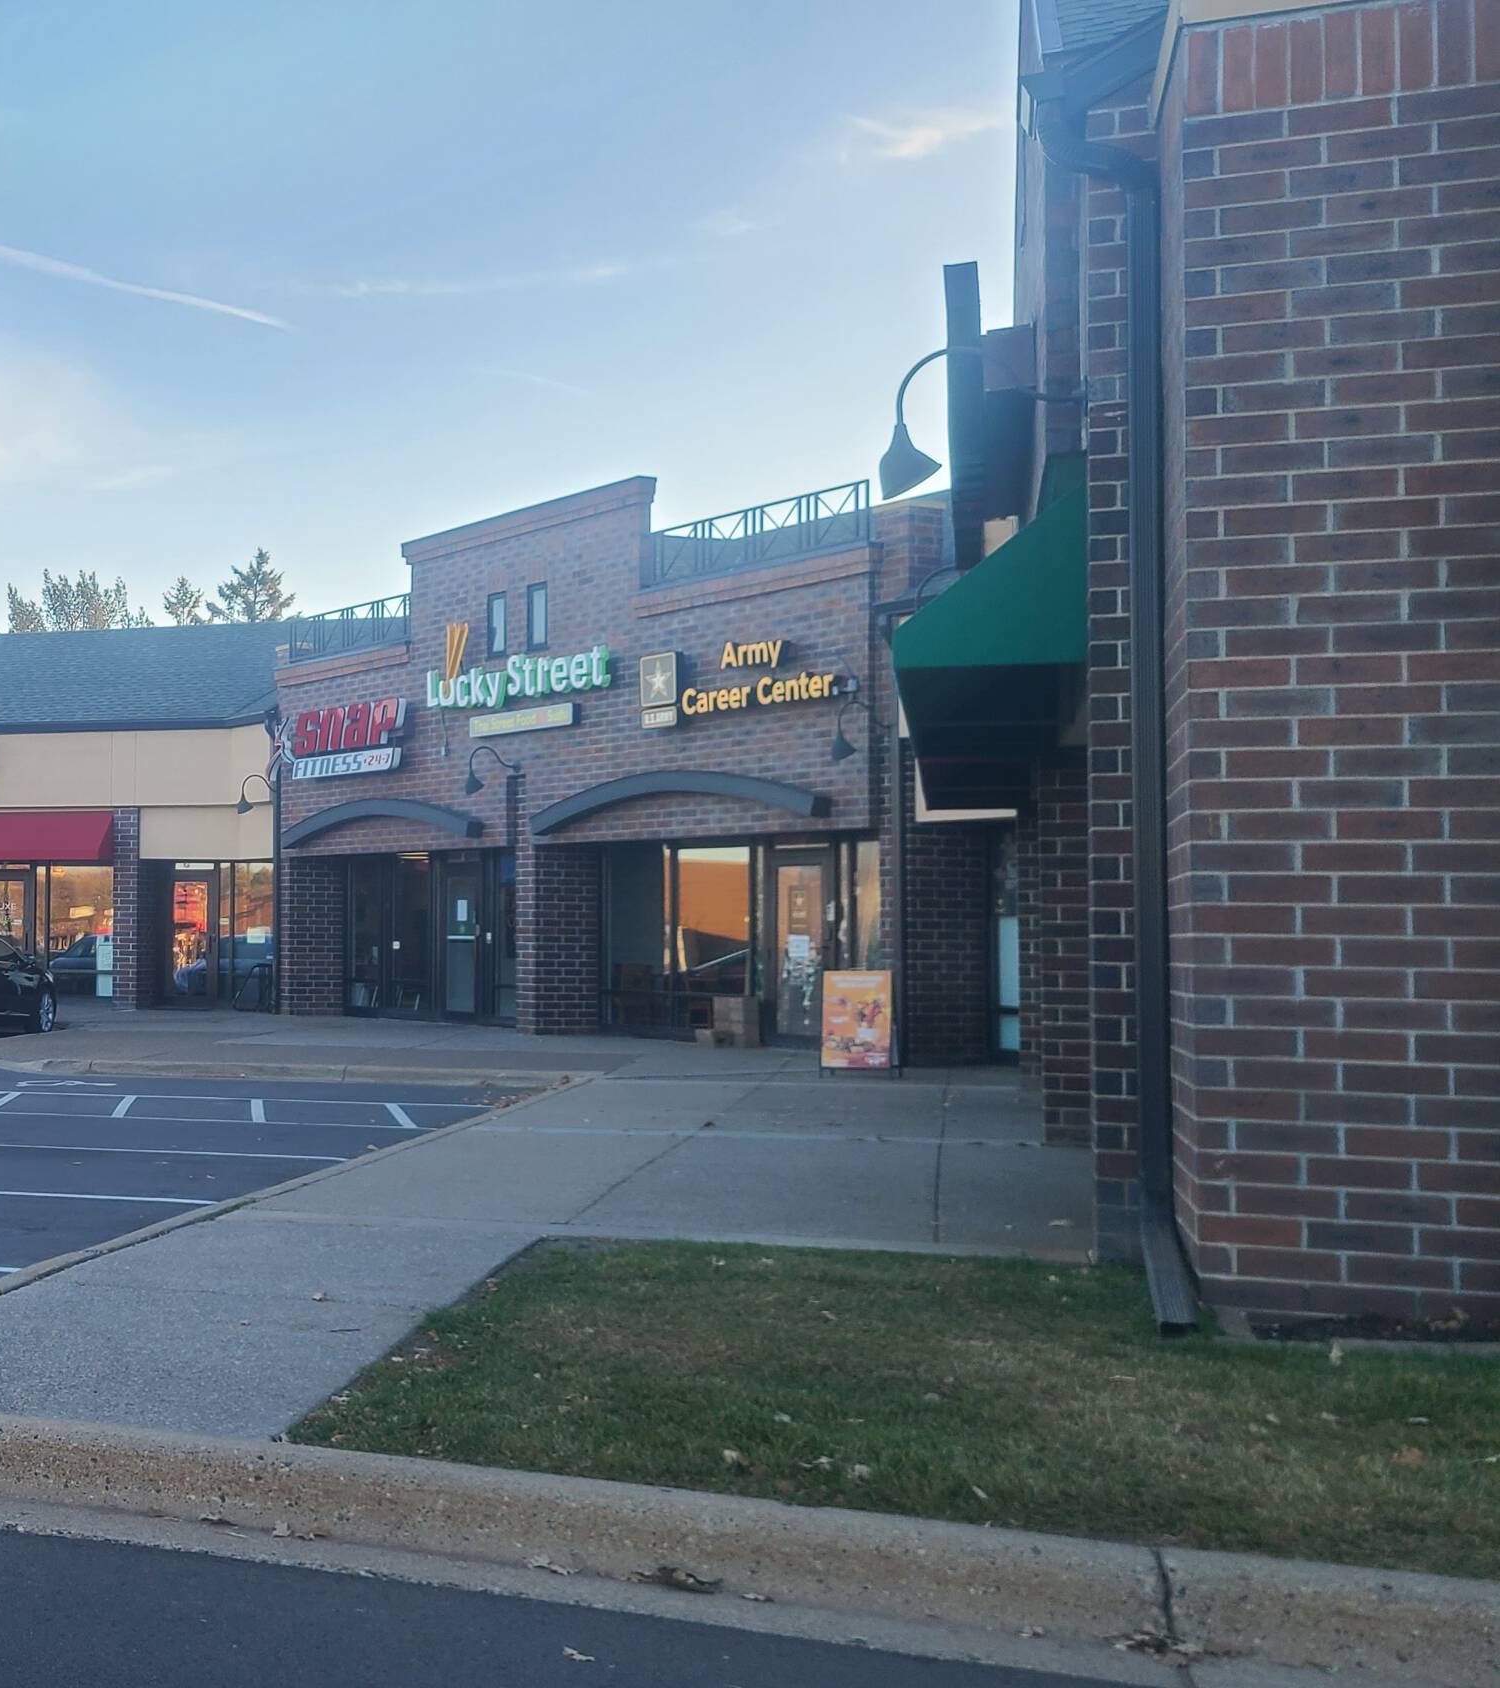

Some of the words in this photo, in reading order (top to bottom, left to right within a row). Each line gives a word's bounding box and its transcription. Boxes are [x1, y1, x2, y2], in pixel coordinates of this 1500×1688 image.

[720, 639, 782, 669] Army
[426, 667, 505, 708] Lucky
[507, 645, 608, 696] Street
[682, 685, 751, 715] Career
[756, 671, 834, 705] Center
